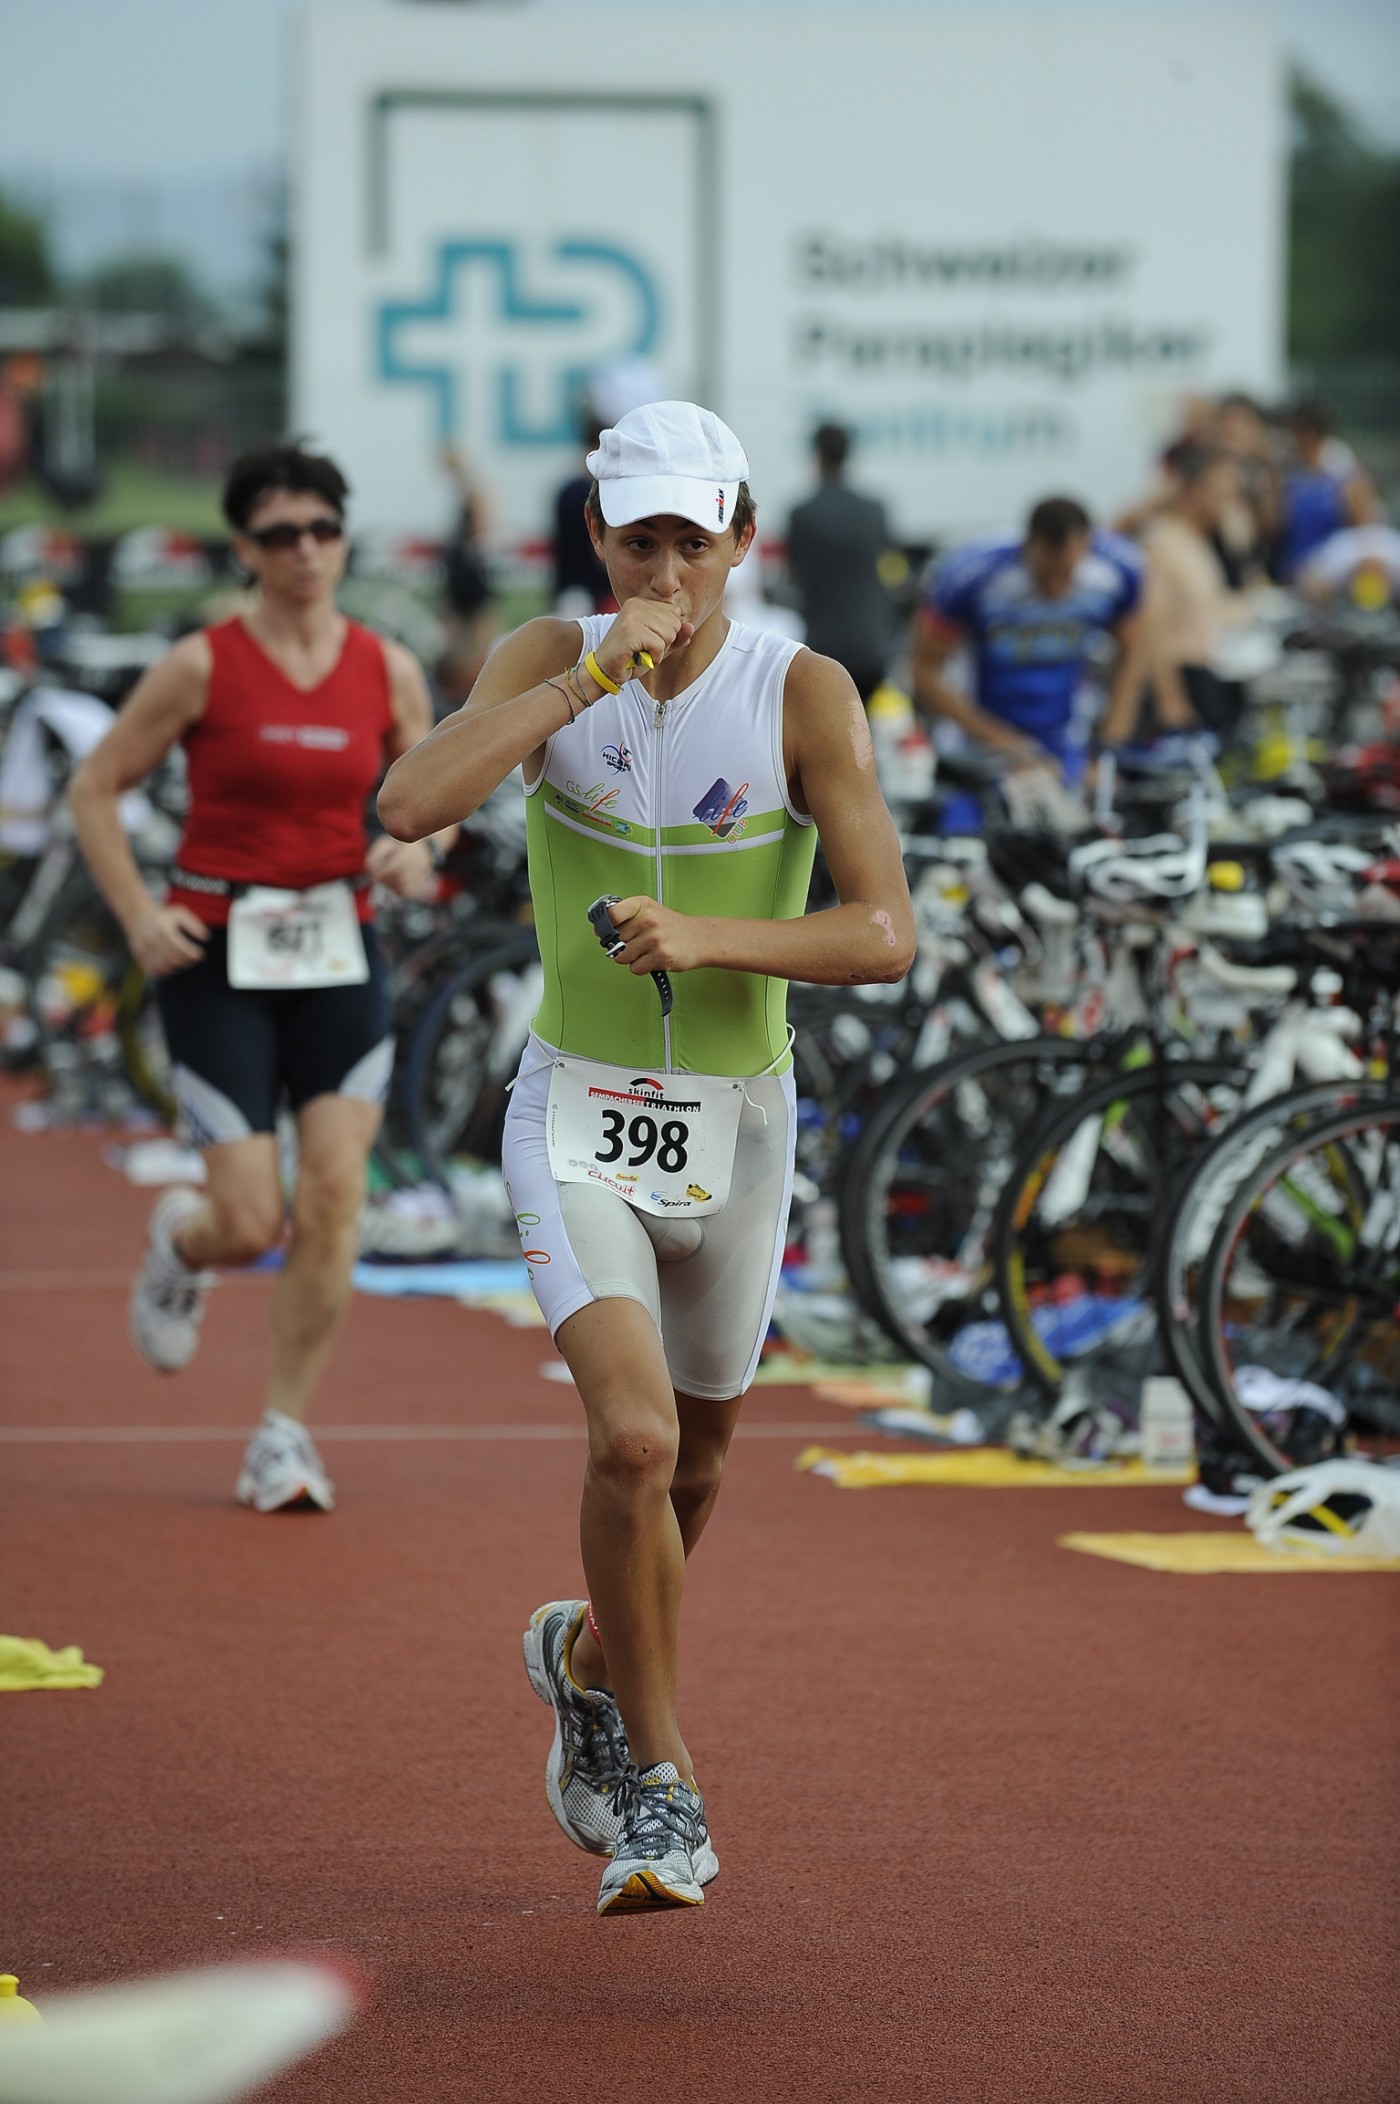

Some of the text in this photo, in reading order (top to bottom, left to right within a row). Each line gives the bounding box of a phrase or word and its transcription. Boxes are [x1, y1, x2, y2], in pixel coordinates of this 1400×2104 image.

[804, 391, 1062, 447] Zntrum
[628, 1087, 665, 1100] skinfit
[594, 1109, 690, 1174] 398
[657, 1198, 692, 1208] Spira
